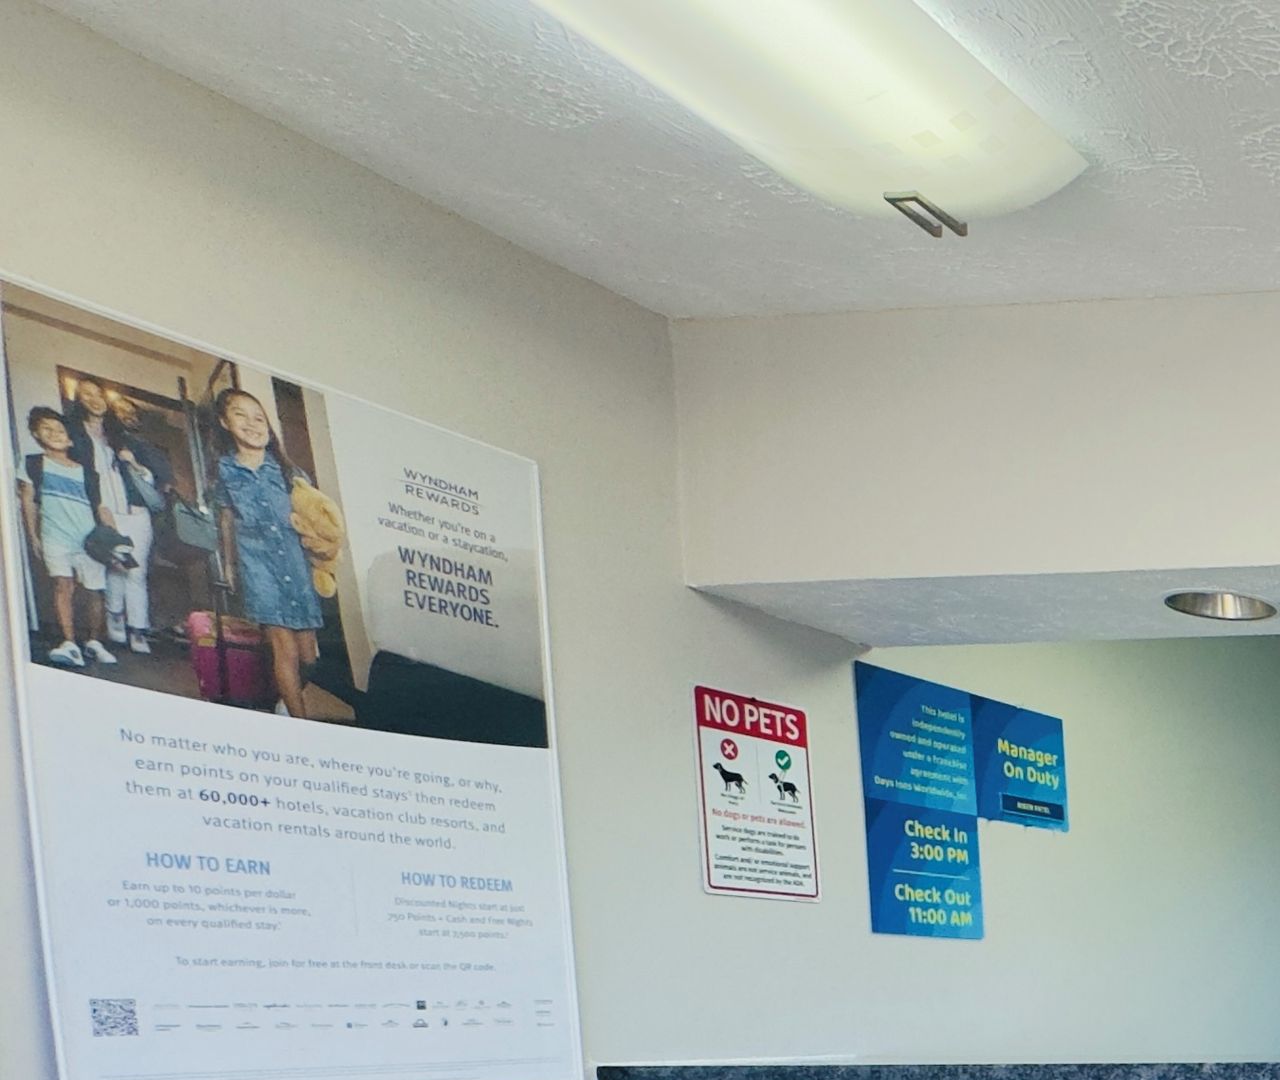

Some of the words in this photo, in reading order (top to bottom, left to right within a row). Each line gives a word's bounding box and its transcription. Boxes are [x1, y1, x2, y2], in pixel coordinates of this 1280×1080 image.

[403, 467, 479, 500] WYNDHAM
[405, 484, 480, 515] REWARDS
[388, 502, 435, 525] Whether
[438, 519, 471, 536] you're
[474, 529, 487, 540] on
[490, 534, 495, 542] a
[378, 517, 425, 537] vacation
[428, 530, 439, 541] or
[442, 535, 448, 544] a
[452, 537, 508, 562] staycation,
[398, 546, 493, 585] WYNDHAM
[406, 569, 490, 605] REWARDS
[404, 590, 499, 628] EVERYONE.
[704, 694, 739, 727] NO
[744, 704, 799, 740] PETS
[120, 728, 144, 744] No
[151, 735, 208, 752] matter
[212, 744, 247, 758] who
[252, 750, 280, 762] you
[285, 754, 314, 768] are,
[319, 758, 364, 774] where
[367, 765, 410, 778] you're
[414, 772, 455, 788] going,
[458, 778, 471, 788] or
[998, 737, 1058, 767] Manager
[135, 758, 174, 772] earn
[180, 763, 234, 780] points
[239, 771, 259, 783] on
[264, 775, 298, 788] your
[302, 779, 368, 796] qualified
[415, 791, 445, 806] then
[450, 798, 496, 812] redeem
[1004, 761, 1024, 780] On
[1027, 766, 1059, 790] Duty
[125, 780, 171, 797] them
[177, 787, 192, 799] at
[199, 789, 270, 807] 60,000+
[276, 798, 329, 816] hotels,
[332, 806, 393, 821] vacation
[398, 811, 426, 825] club
[430, 817, 479, 832] resorts,
[482, 822, 506, 834] and
[202, 816, 273, 832] vacation
[278, 824, 330, 838] rentals
[335, 829, 385, 843] around
[390, 833, 411, 846] the
[415, 837, 456, 850] world.
[905, 820, 950, 841] Check
[954, 828, 968, 844] In
[146, 852, 191, 870] HOW
[197, 856, 219, 871] TO
[226, 858, 270, 875] EARN
[910, 842, 943, 861] 3:00
[947, 847, 969, 865] PM
[122, 880, 150, 891] Earn
[154, 884, 169, 893] up
[172, 884, 184, 894] to
[189, 885, 201, 894] 10
[205, 885, 241, 897] points
[244, 888, 262, 899] per
[265, 889, 296, 900] dollar
[402, 872, 435, 886] HOW
[440, 874, 456, 888] TO
[461, 876, 513, 892] REDEEM
[894, 883, 940, 903] Check
[944, 889, 972, 906] Out
[146, 917, 163, 926] on
[166, 919, 198, 928] every
[201, 919, 252, 929] qualified
[208, 903, 266, 914] whichever
[269, 905, 278, 914] is
[909, 907, 947, 924] 11:00
[951, 910, 972, 926] AM
